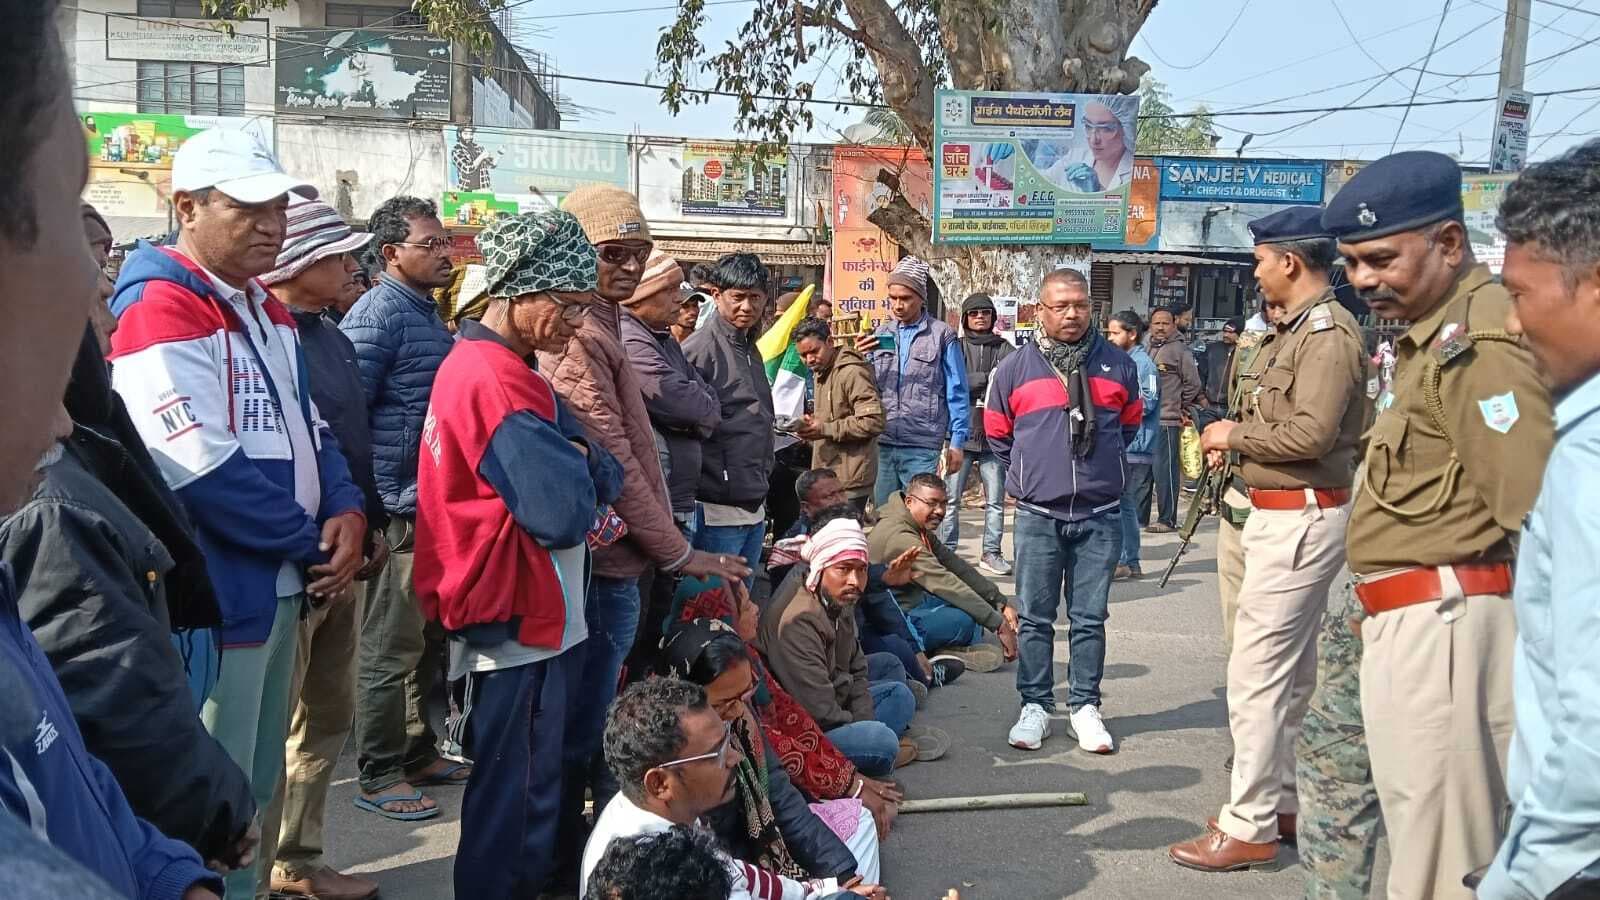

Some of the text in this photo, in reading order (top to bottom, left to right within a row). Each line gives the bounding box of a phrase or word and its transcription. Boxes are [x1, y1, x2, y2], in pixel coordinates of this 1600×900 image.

[512, 136, 616, 173] SRI RAJ
[944, 146, 969, 164] जाँच
[1168, 163, 1314, 186] SANJEEV MEDICAL
[1032, 191, 1055, 201] E.C.G.
[1197, 185, 1236, 196] CHEMIST
[1243, 187, 1287, 198] DRUGGIST
[858, 277, 875, 291] की
[839, 296, 876, 313] सुविधा
[161, 402, 196, 433] NYC
